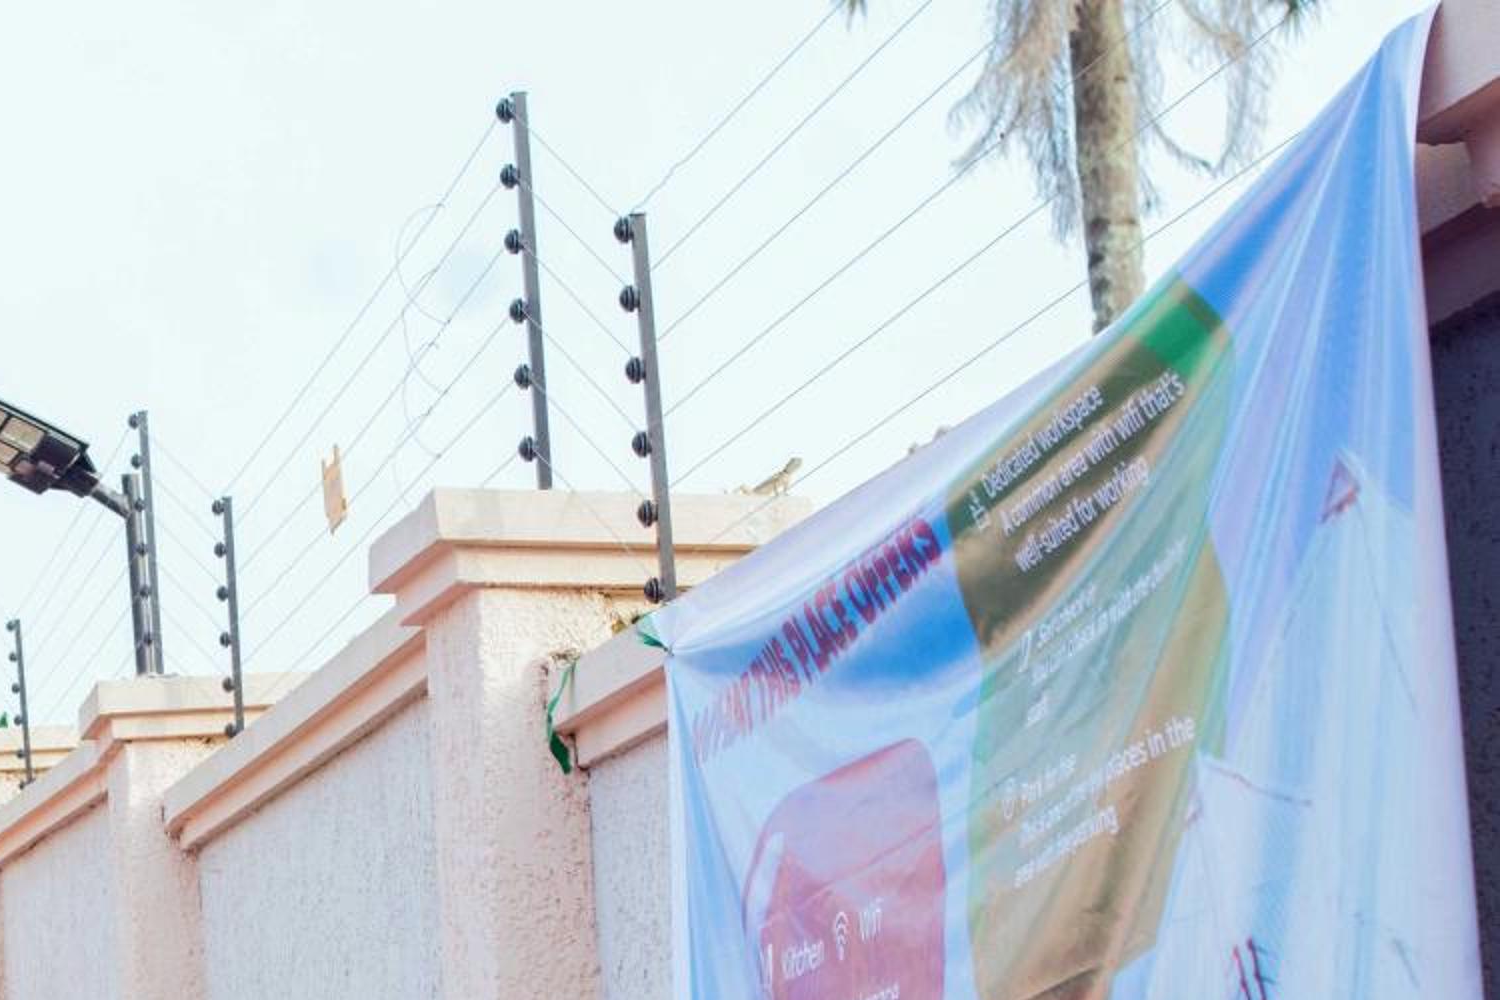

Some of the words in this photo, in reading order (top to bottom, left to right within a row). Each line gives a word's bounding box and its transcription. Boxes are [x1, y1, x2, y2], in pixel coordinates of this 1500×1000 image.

[982, 431, 1041, 498] Dedicated
[1034, 386, 1103, 451] workspace
[1000, 509, 1014, 537] A
[1010, 475, 1062, 527] common
[1058, 452, 1088, 486] area
[1085, 425, 1120, 465] with
[1141, 370, 1185, 426] that's
[1014, 497, 1081, 573] well-suited
[1076, 497, 1098, 527] for
[1093, 455, 1150, 512] working
[781, 577, 858, 687] PLACE
[1146, 729, 1168, 760] in
[1164, 715, 1196, 749] the
[781, 938, 825, 981] Kitchen
